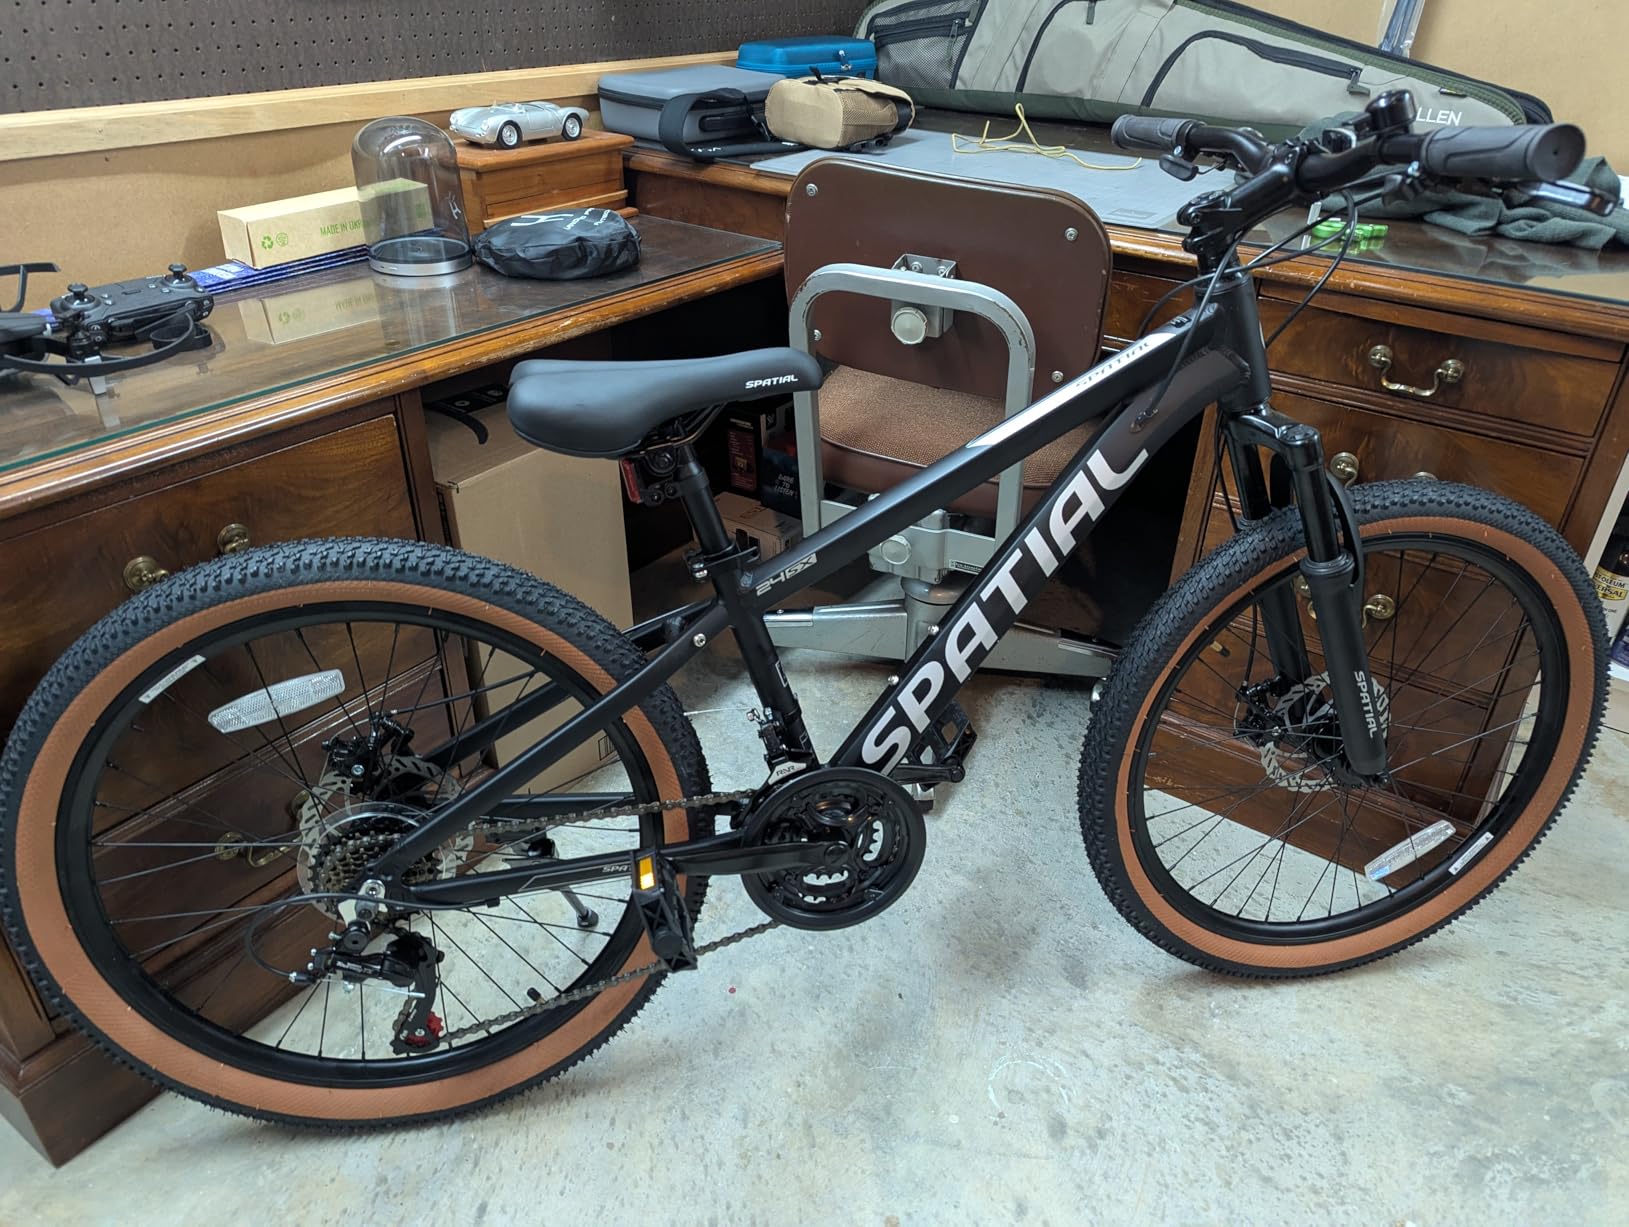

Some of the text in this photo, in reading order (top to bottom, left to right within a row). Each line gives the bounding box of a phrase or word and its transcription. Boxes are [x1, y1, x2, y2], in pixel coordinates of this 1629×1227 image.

[320, 222, 340, 237] MADE
[340, 221, 348, 232] IN
[745, 374, 799, 389] SPATIAL
[861, 448, 1149, 777] SPATIAL
[1354, 670, 1378, 739] SPATIAL
